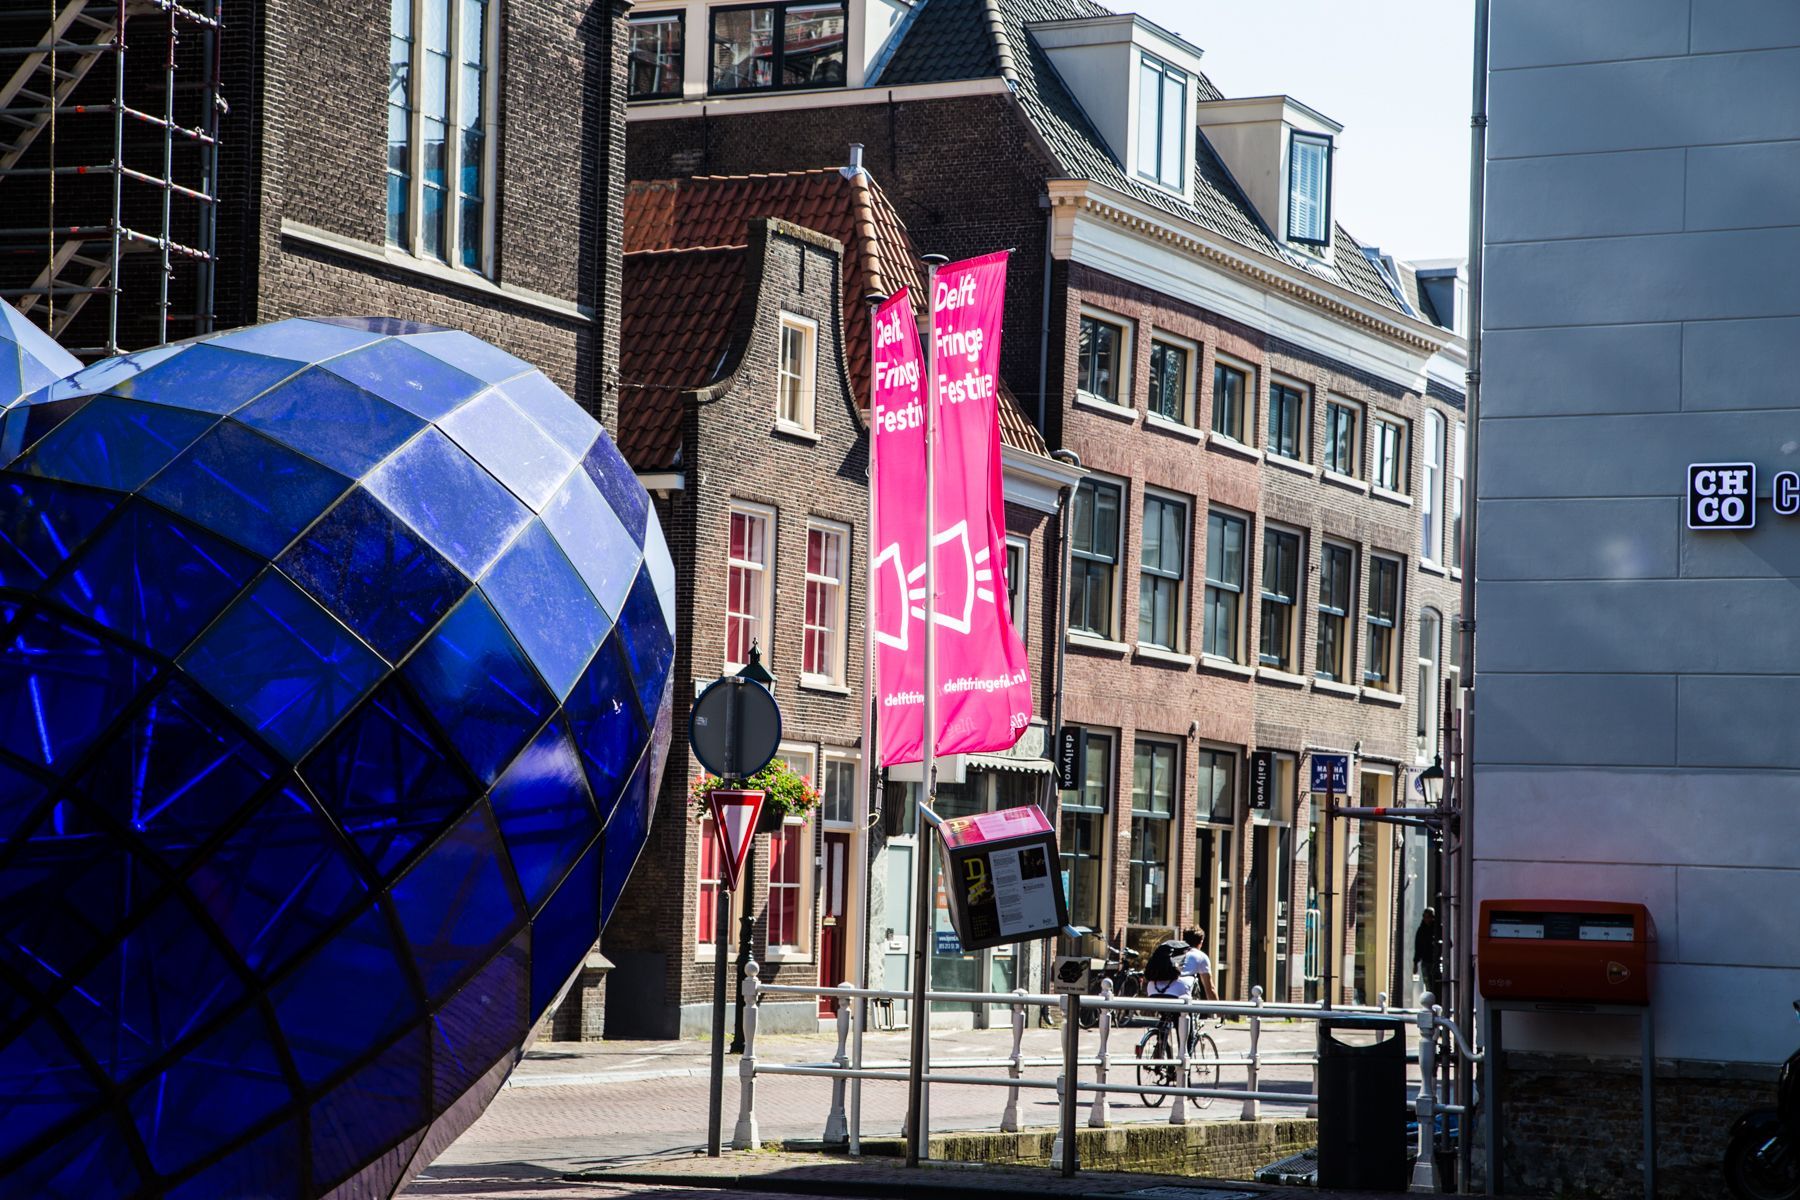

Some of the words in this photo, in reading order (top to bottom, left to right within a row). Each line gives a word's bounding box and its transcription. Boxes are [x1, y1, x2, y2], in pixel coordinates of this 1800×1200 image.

[935, 274, 977, 312] Delft
[935, 325, 983, 362] Fringe
[1695, 470, 1748, 496] CH
[1697, 496, 1745, 523] CO
[1063, 734, 1075, 787] dailywok
[1316, 765, 1344, 774] MAHA
[1256, 759, 1267, 807] dailywok
